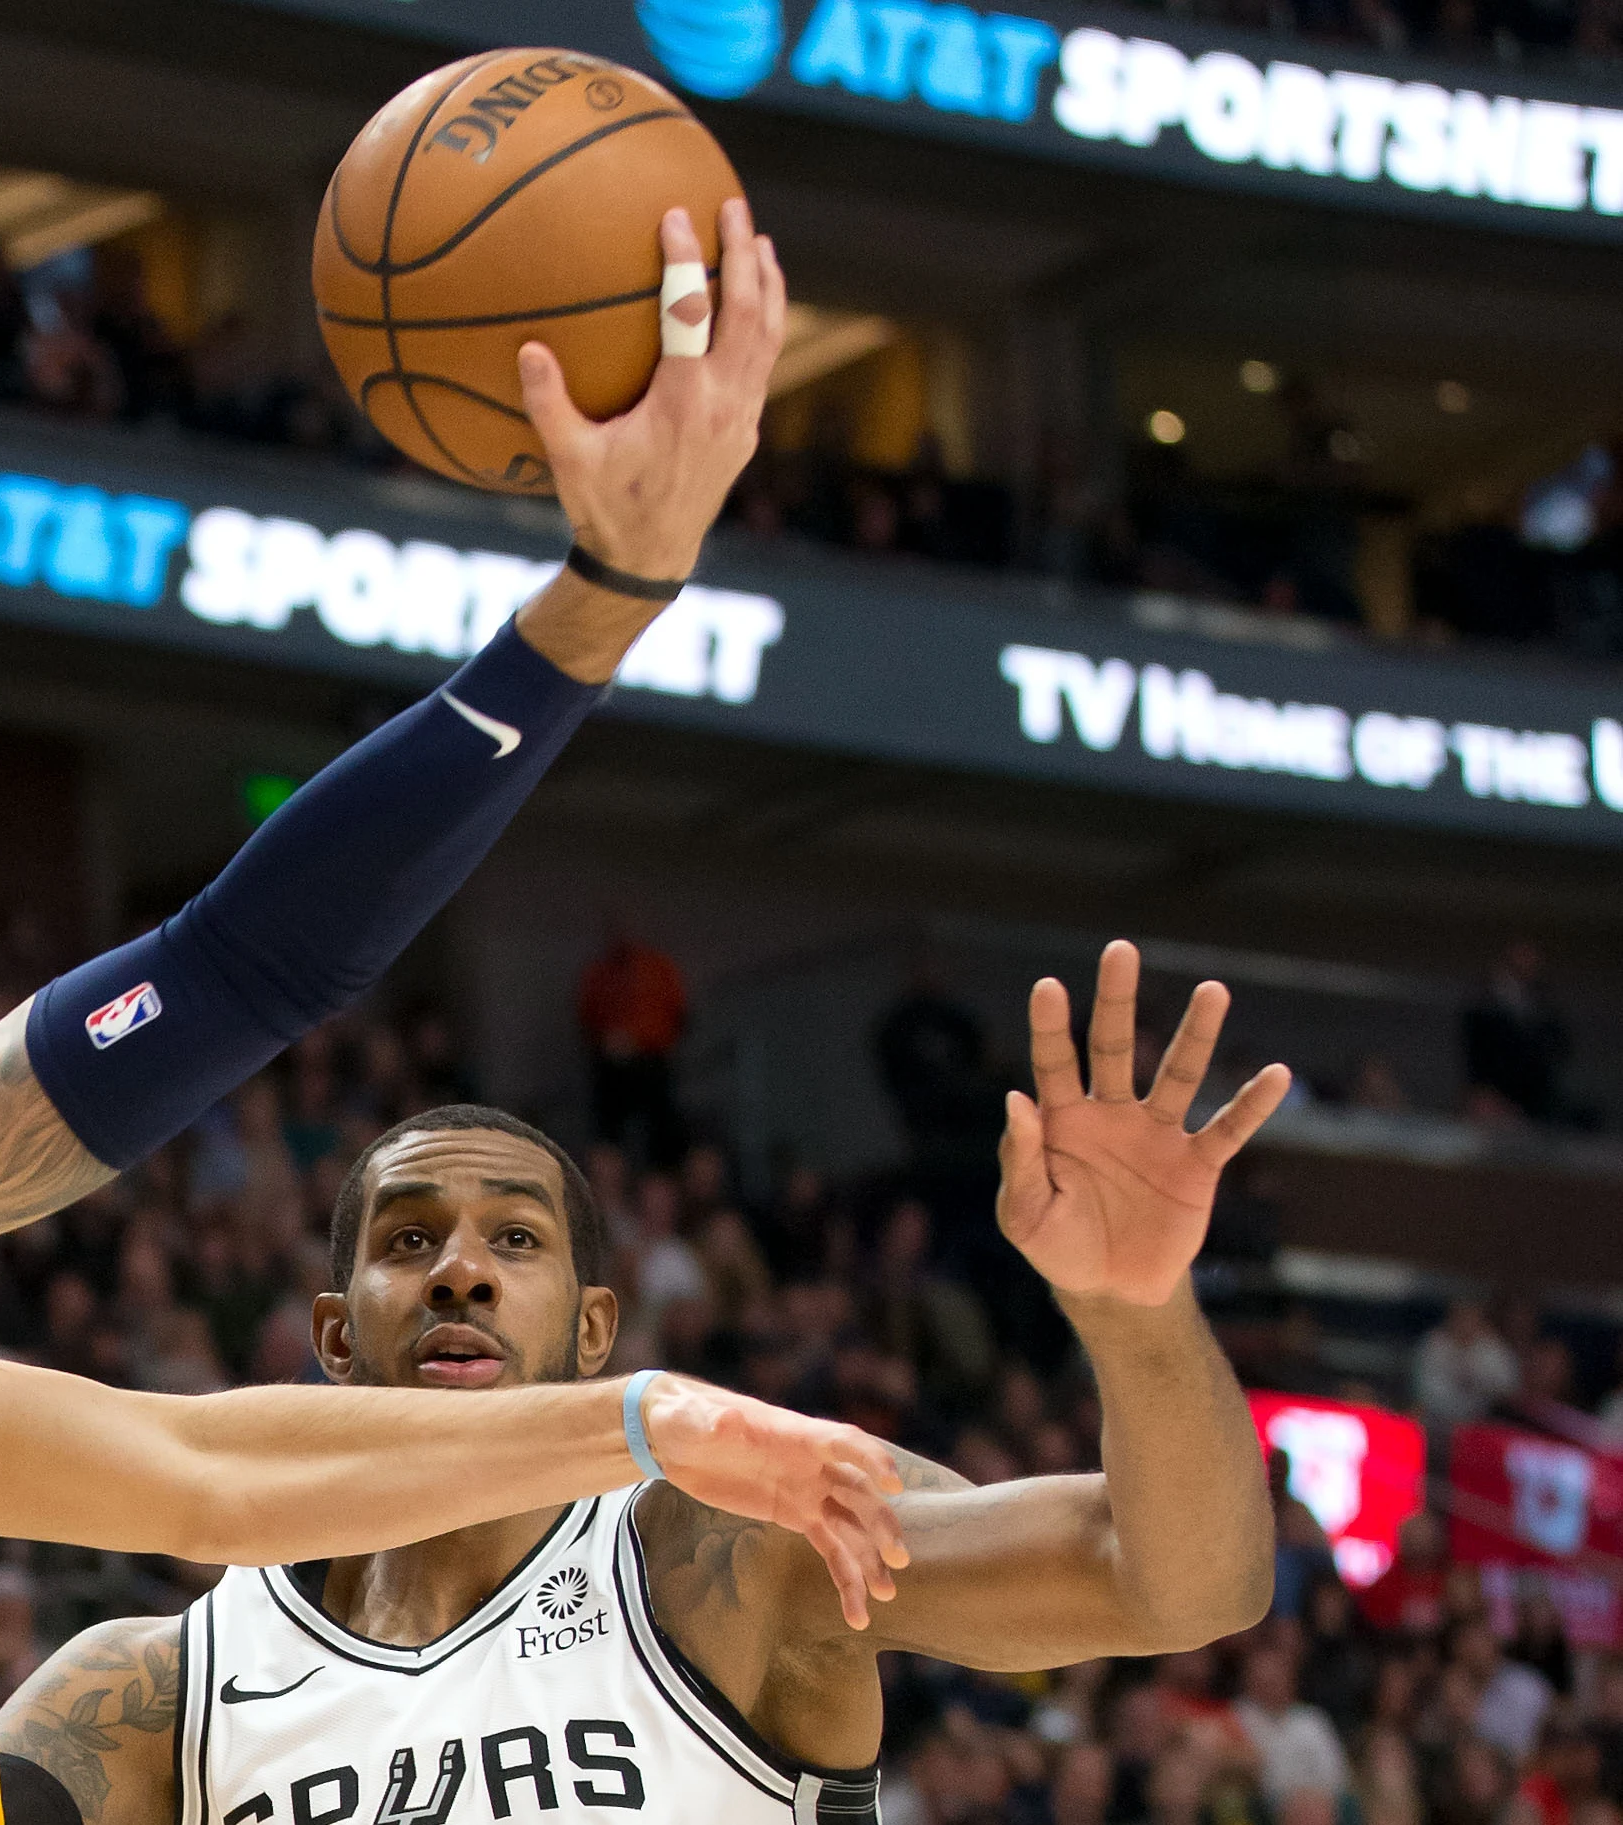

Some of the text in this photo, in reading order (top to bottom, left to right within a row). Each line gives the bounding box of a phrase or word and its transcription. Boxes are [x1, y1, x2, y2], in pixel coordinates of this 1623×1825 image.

[423, 57, 583, 165] DING
[789, 0, 1623, 216] AT&T SPORTSNET
[999, 644, 1135, 752] TV
[1353, 710, 1447, 790] OF
[1448, 721, 1590, 808] THE
[515, 1608, 609, 1659] Frost
